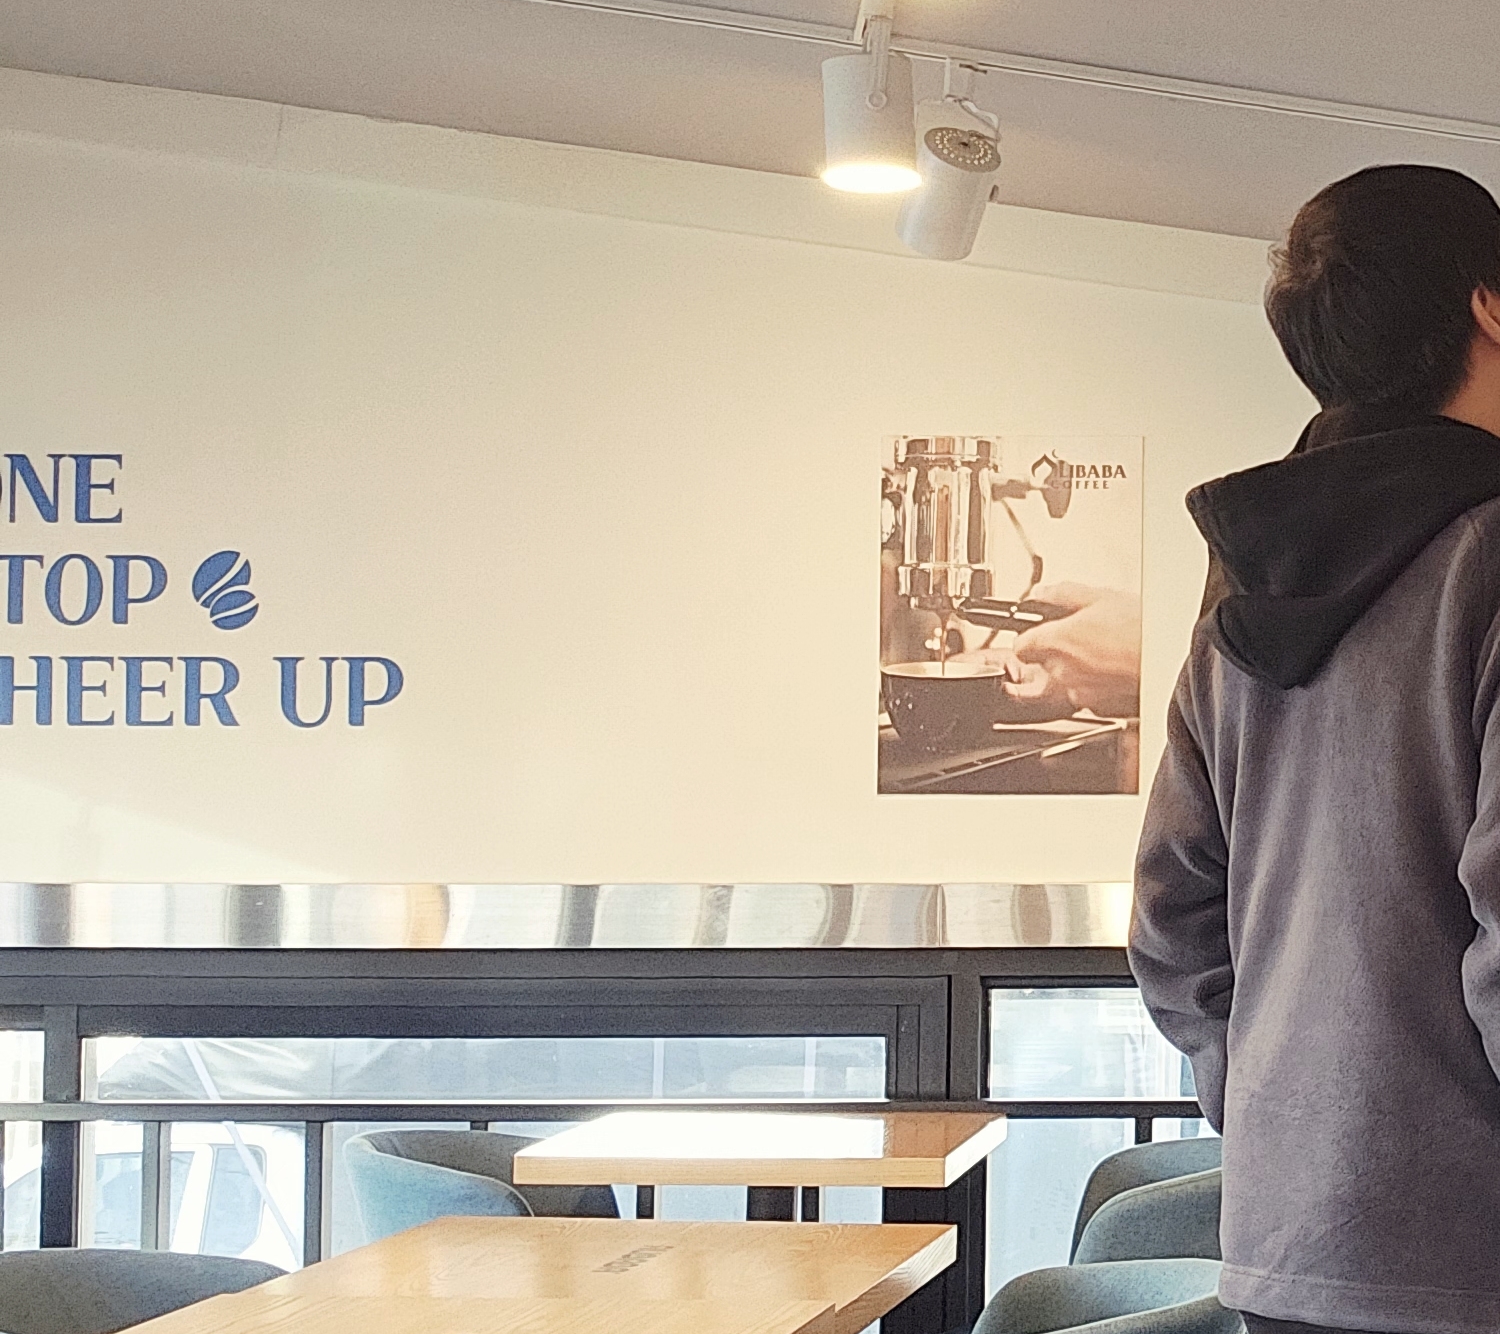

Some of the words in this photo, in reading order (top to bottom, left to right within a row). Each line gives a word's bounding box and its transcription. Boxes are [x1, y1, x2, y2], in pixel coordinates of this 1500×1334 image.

[0, 453, 123, 523] NE
[1051, 480, 1110, 490] COFFEE
[273, 656, 404, 728] UP
